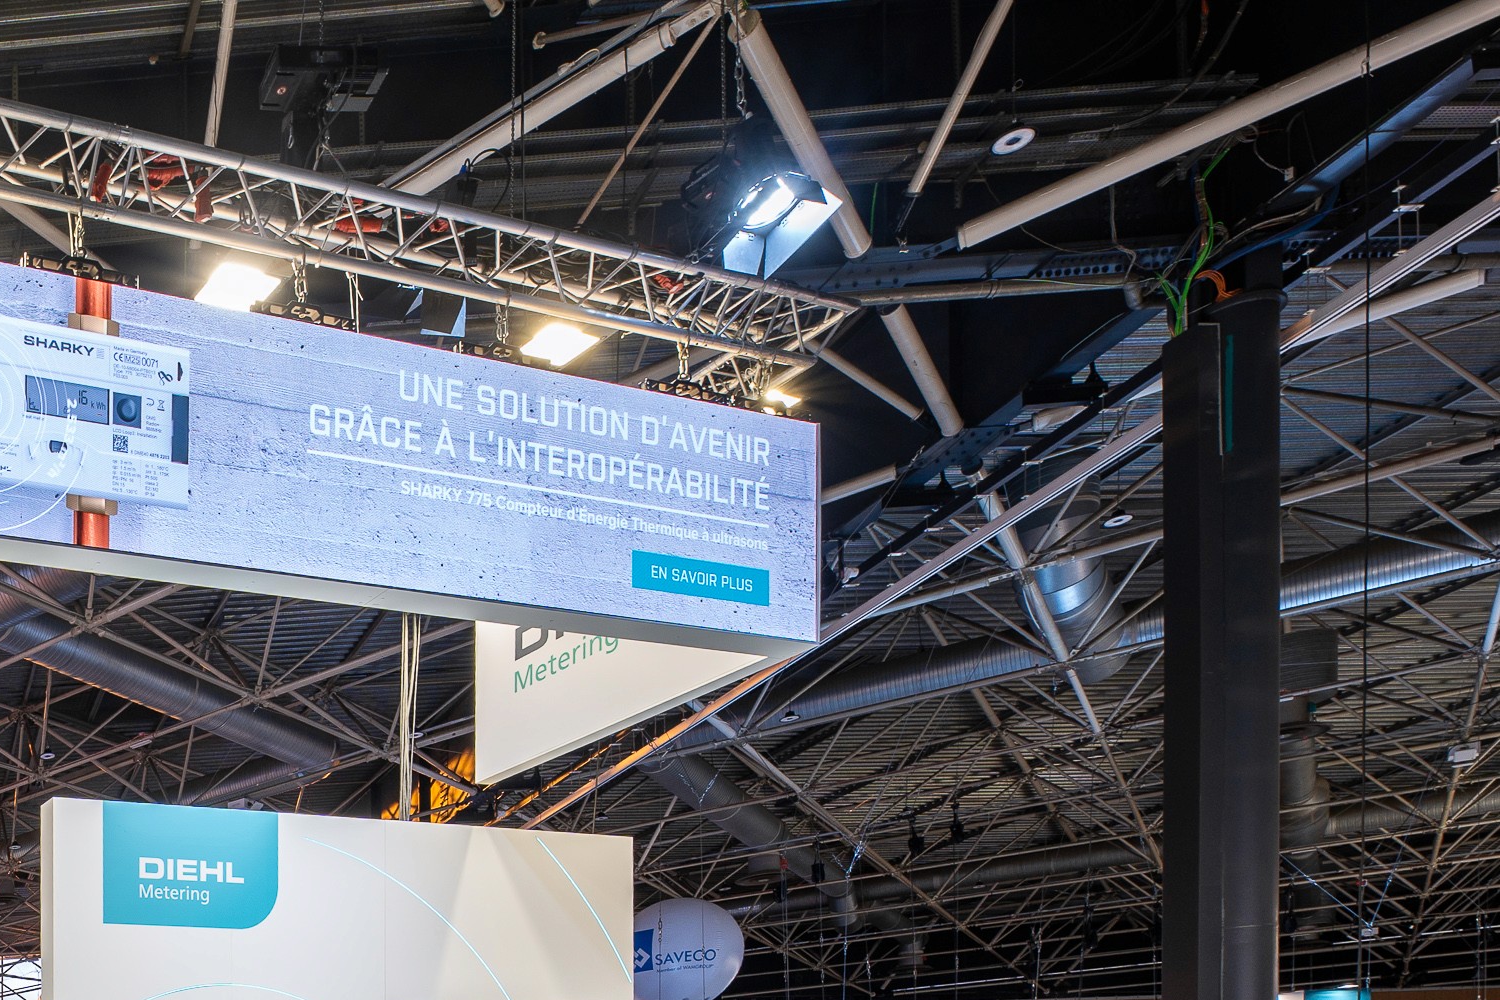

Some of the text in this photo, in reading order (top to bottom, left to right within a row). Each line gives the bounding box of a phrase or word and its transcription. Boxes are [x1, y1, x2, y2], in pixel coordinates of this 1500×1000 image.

[24, 334, 94, 357] SHARKY
[142, 357, 158, 368] 0071
[400, 369, 770, 467] UNE SOLUTION D'AVENIR
[309, 404, 770, 511] GRÂCE À L'INTEROPÉRABILITÉ
[400, 480, 768, 550] SHARKY 775 Compteur d'Énergie Thermique à ultrasons
[651, 564, 753, 592] EN SAVOIR PLUS
[514, 636, 618, 693] Metering
[138, 856, 245, 884] DIEHL
[138, 884, 210, 905] Metering
